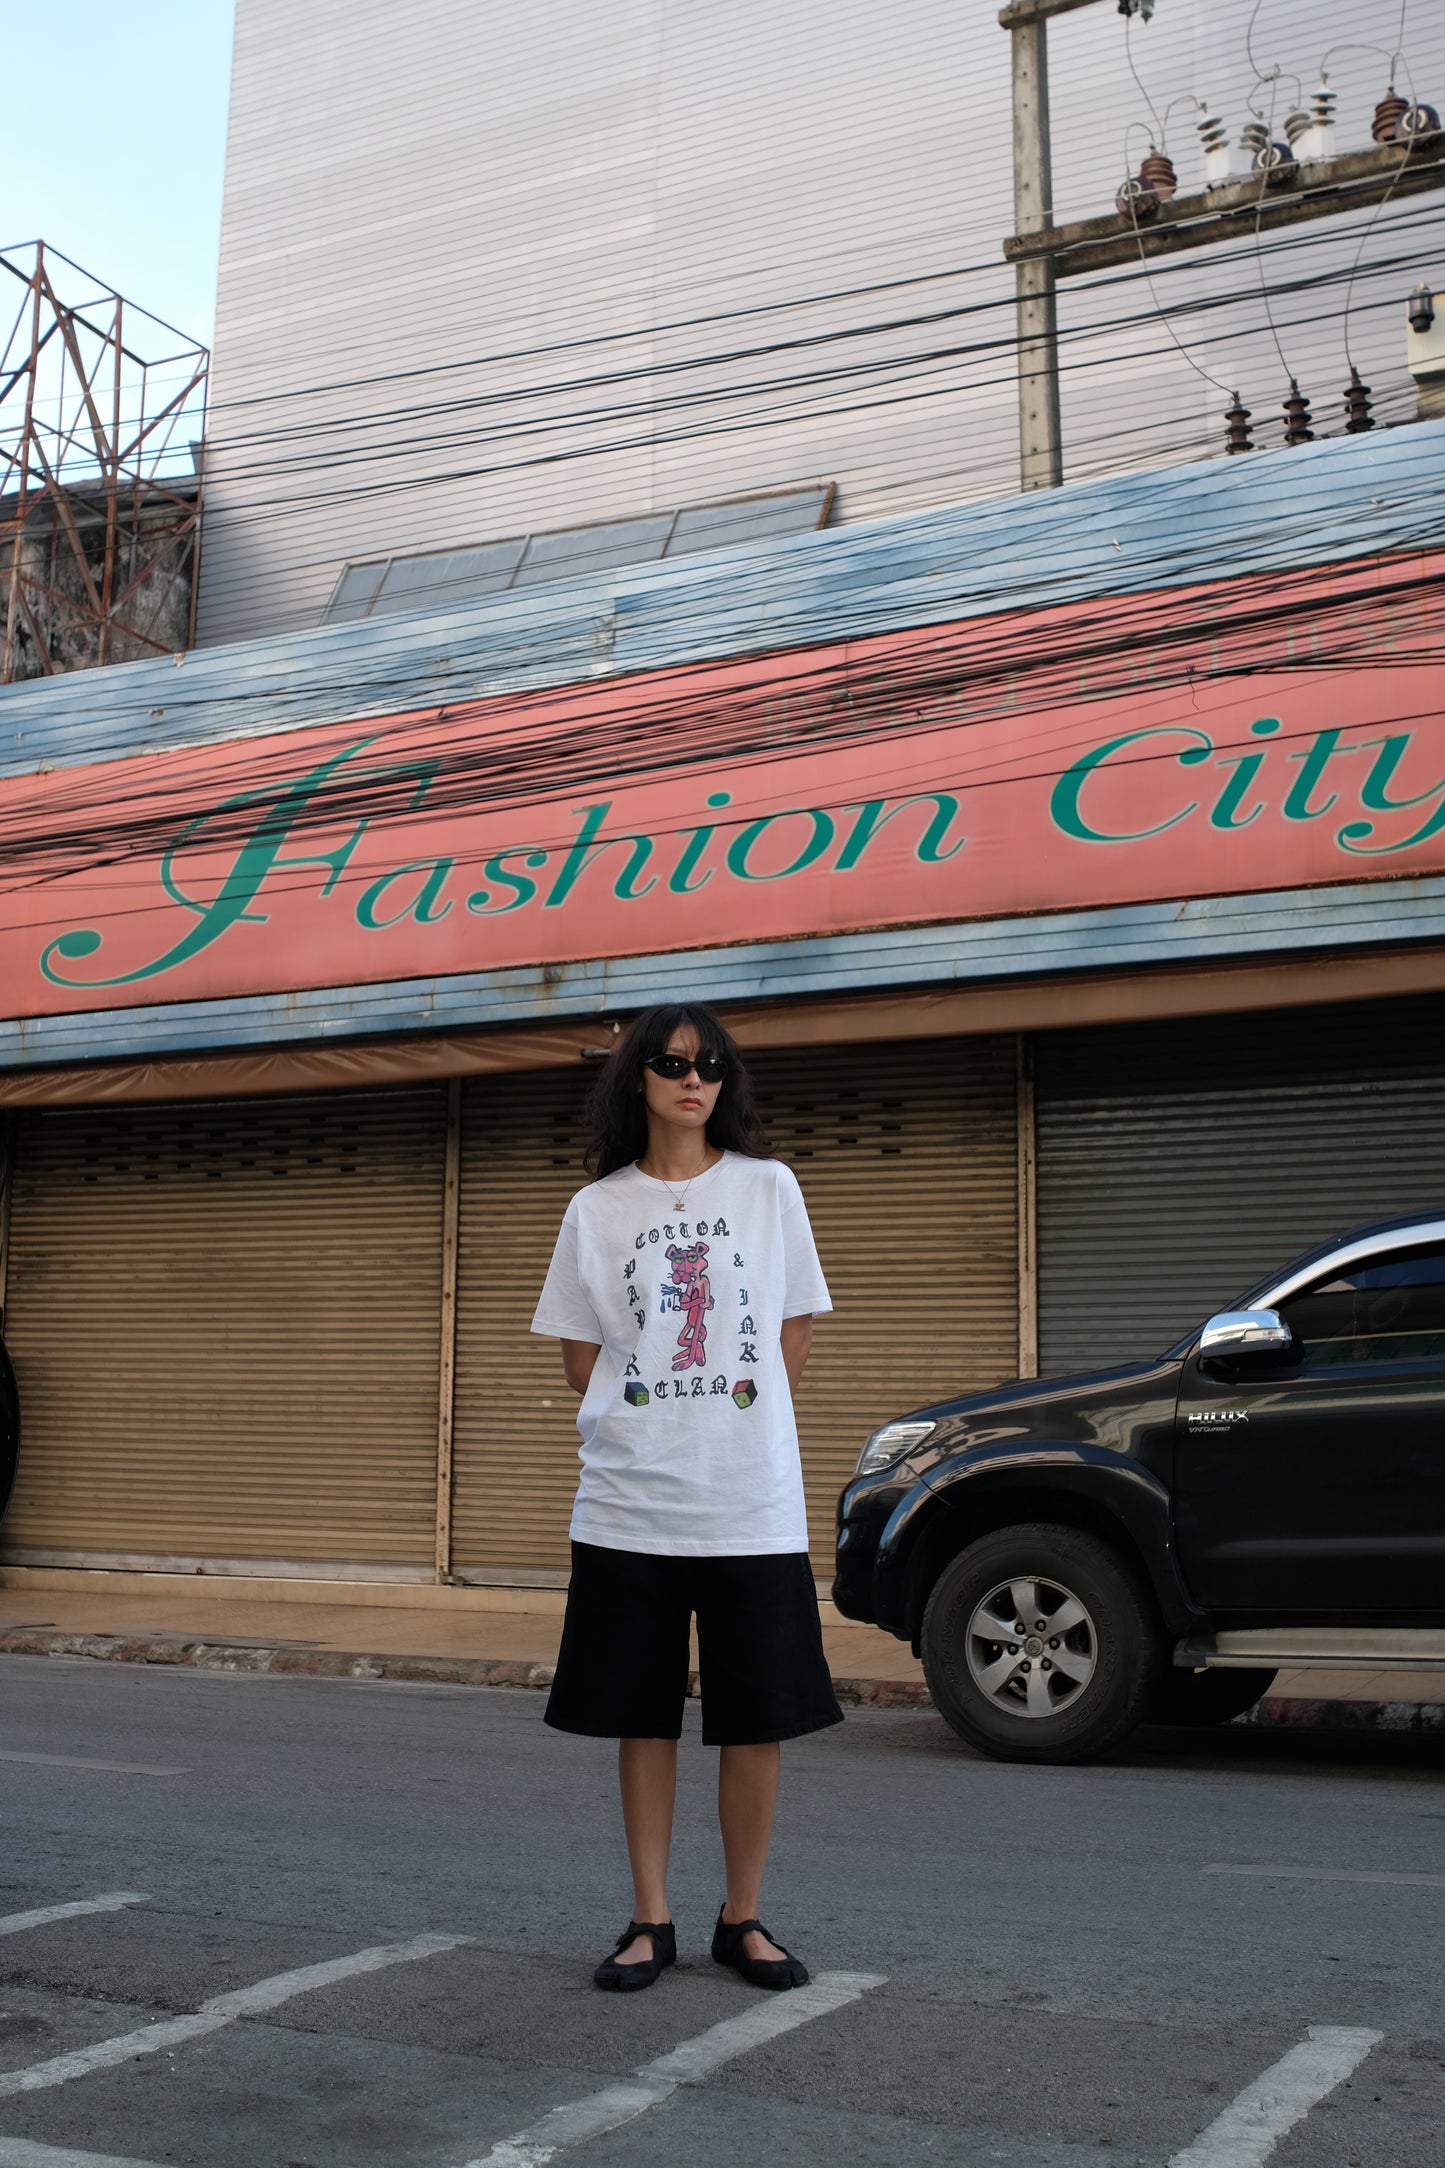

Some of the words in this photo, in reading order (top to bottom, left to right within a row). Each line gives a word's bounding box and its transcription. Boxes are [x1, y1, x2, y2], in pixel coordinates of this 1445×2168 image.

[39, 736, 967, 989] Fashion
[1048, 717, 1445, 857] City
[635, 1217, 730, 1249] COTTON
[733, 1252, 745, 1268] &
[654, 1374, 729, 1399] CLAN
[1188, 1409, 1250, 1424] HILUX
